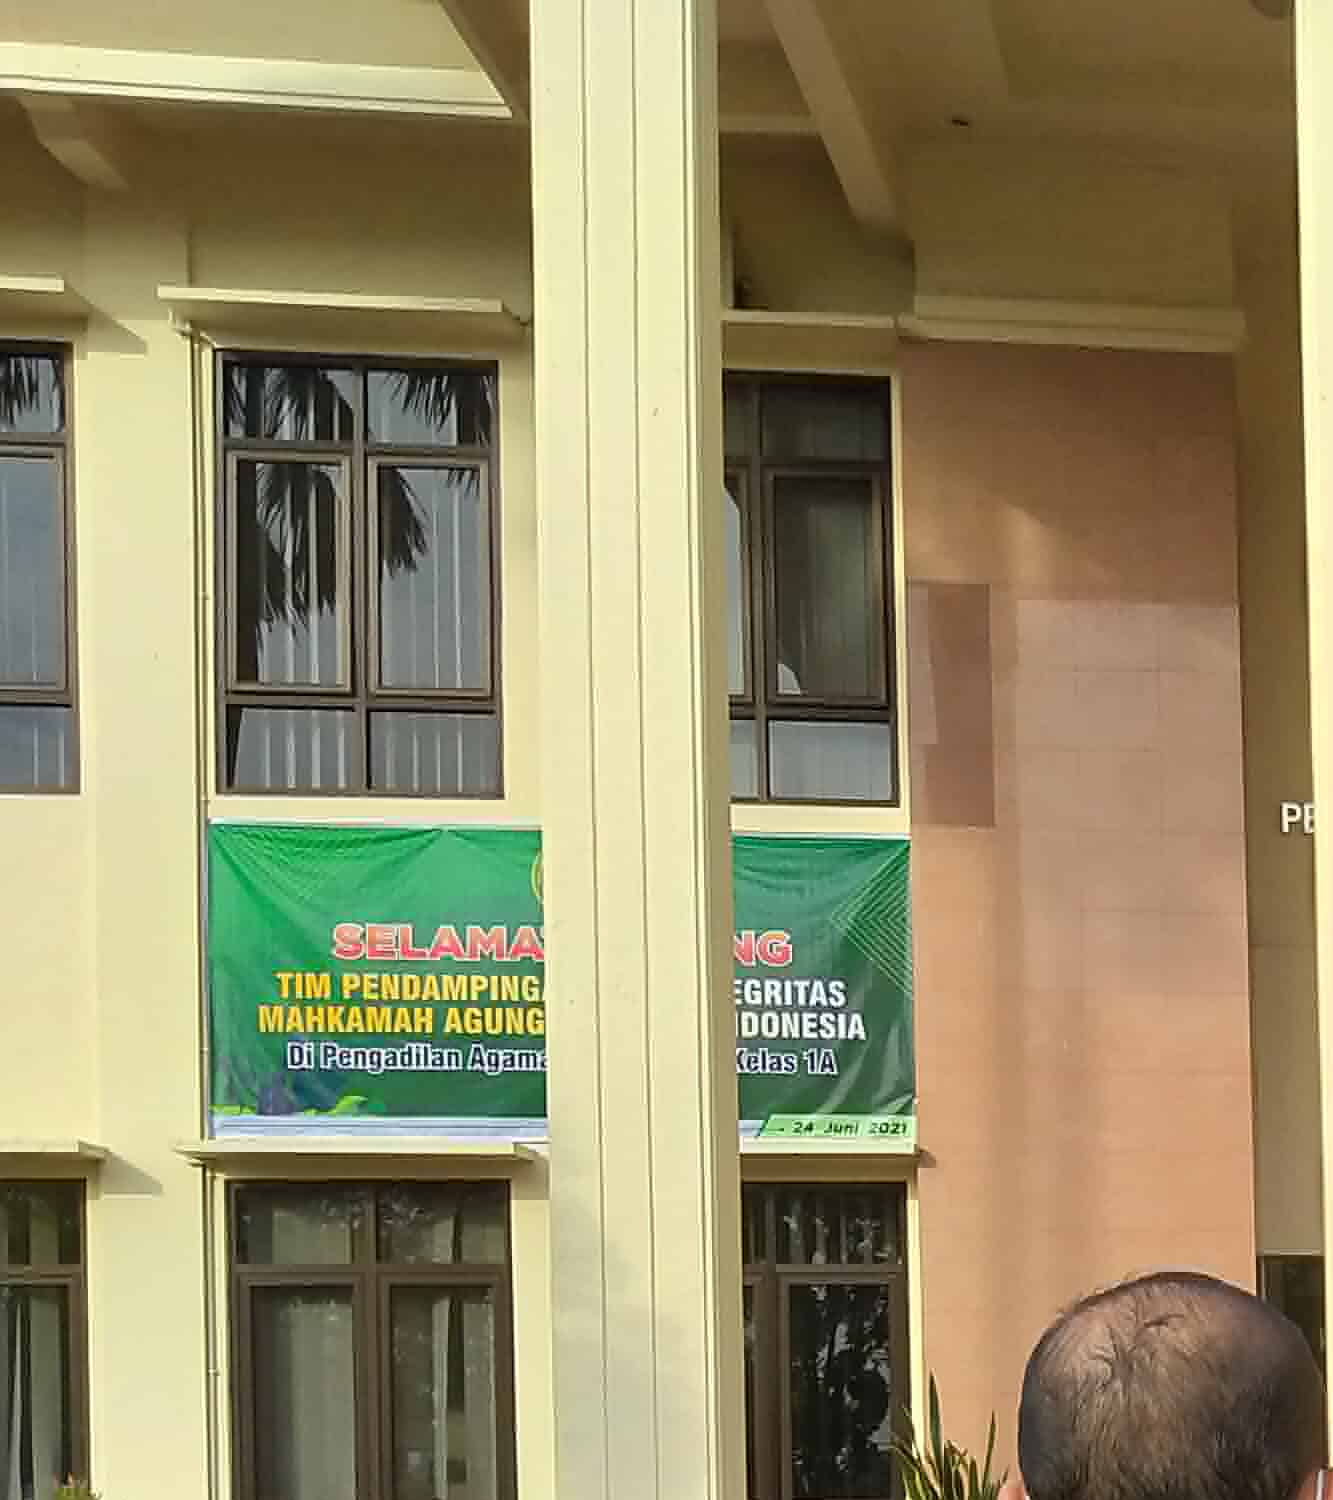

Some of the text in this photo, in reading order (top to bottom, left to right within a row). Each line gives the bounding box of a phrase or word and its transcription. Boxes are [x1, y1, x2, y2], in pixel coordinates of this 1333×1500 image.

[332, 921, 545, 961] SELAMA
[276, 970, 846, 1007] TIM PENDAMPING EGRITAS
[257, 1004, 866, 1040] MAHKAMAH AGUNG DONESIA
[287, 1042, 314, 1070] Di
[319, 1042, 463, 1075] Pengadilan
[792, 1121, 814, 1134] 24
[824, 1121, 858, 1134] Juni
[868, 1121, 907, 1134] 2021
